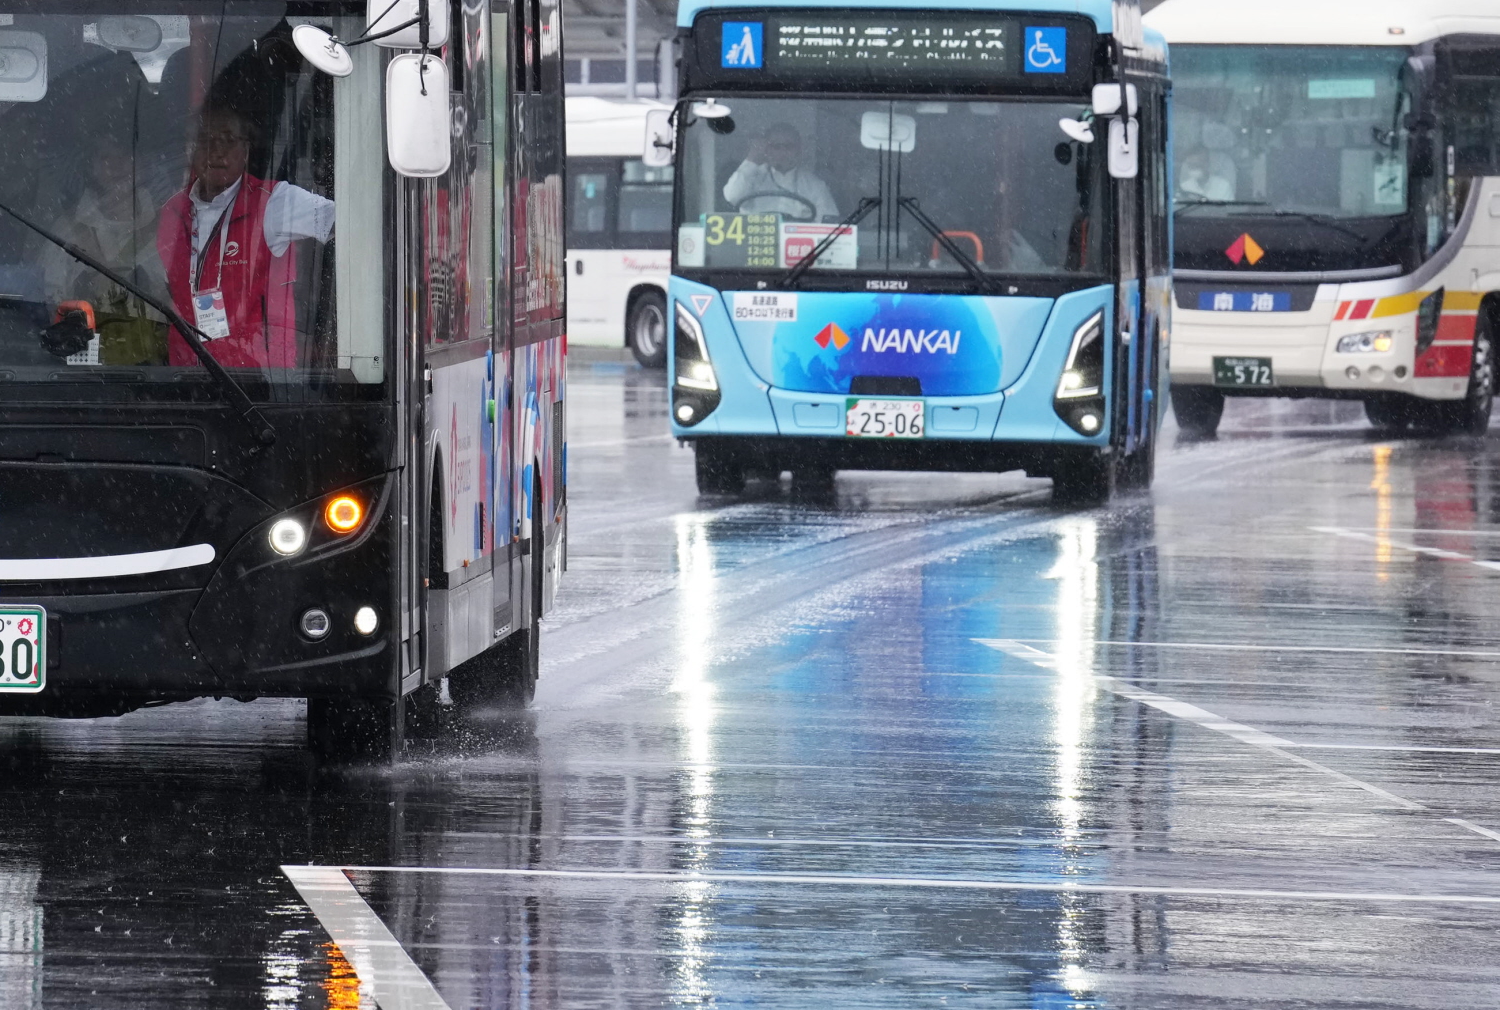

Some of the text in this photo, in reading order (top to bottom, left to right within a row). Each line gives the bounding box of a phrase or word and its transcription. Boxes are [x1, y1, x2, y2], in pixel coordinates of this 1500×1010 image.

[747, 215, 776, 223] 08:40
[706, 215, 746, 246] 34
[747, 225, 776, 234] 09:30
[747, 236, 776, 245] 10:25
[747, 247, 776, 255] 12:45
[747, 257, 776, 266] 14:00
[866, 280, 908, 290] ISUZU
[1213, 292, 1274, 311] 南海
[861, 328, 961, 354] NANKAI
[861, 412, 921, 435] 25-06
